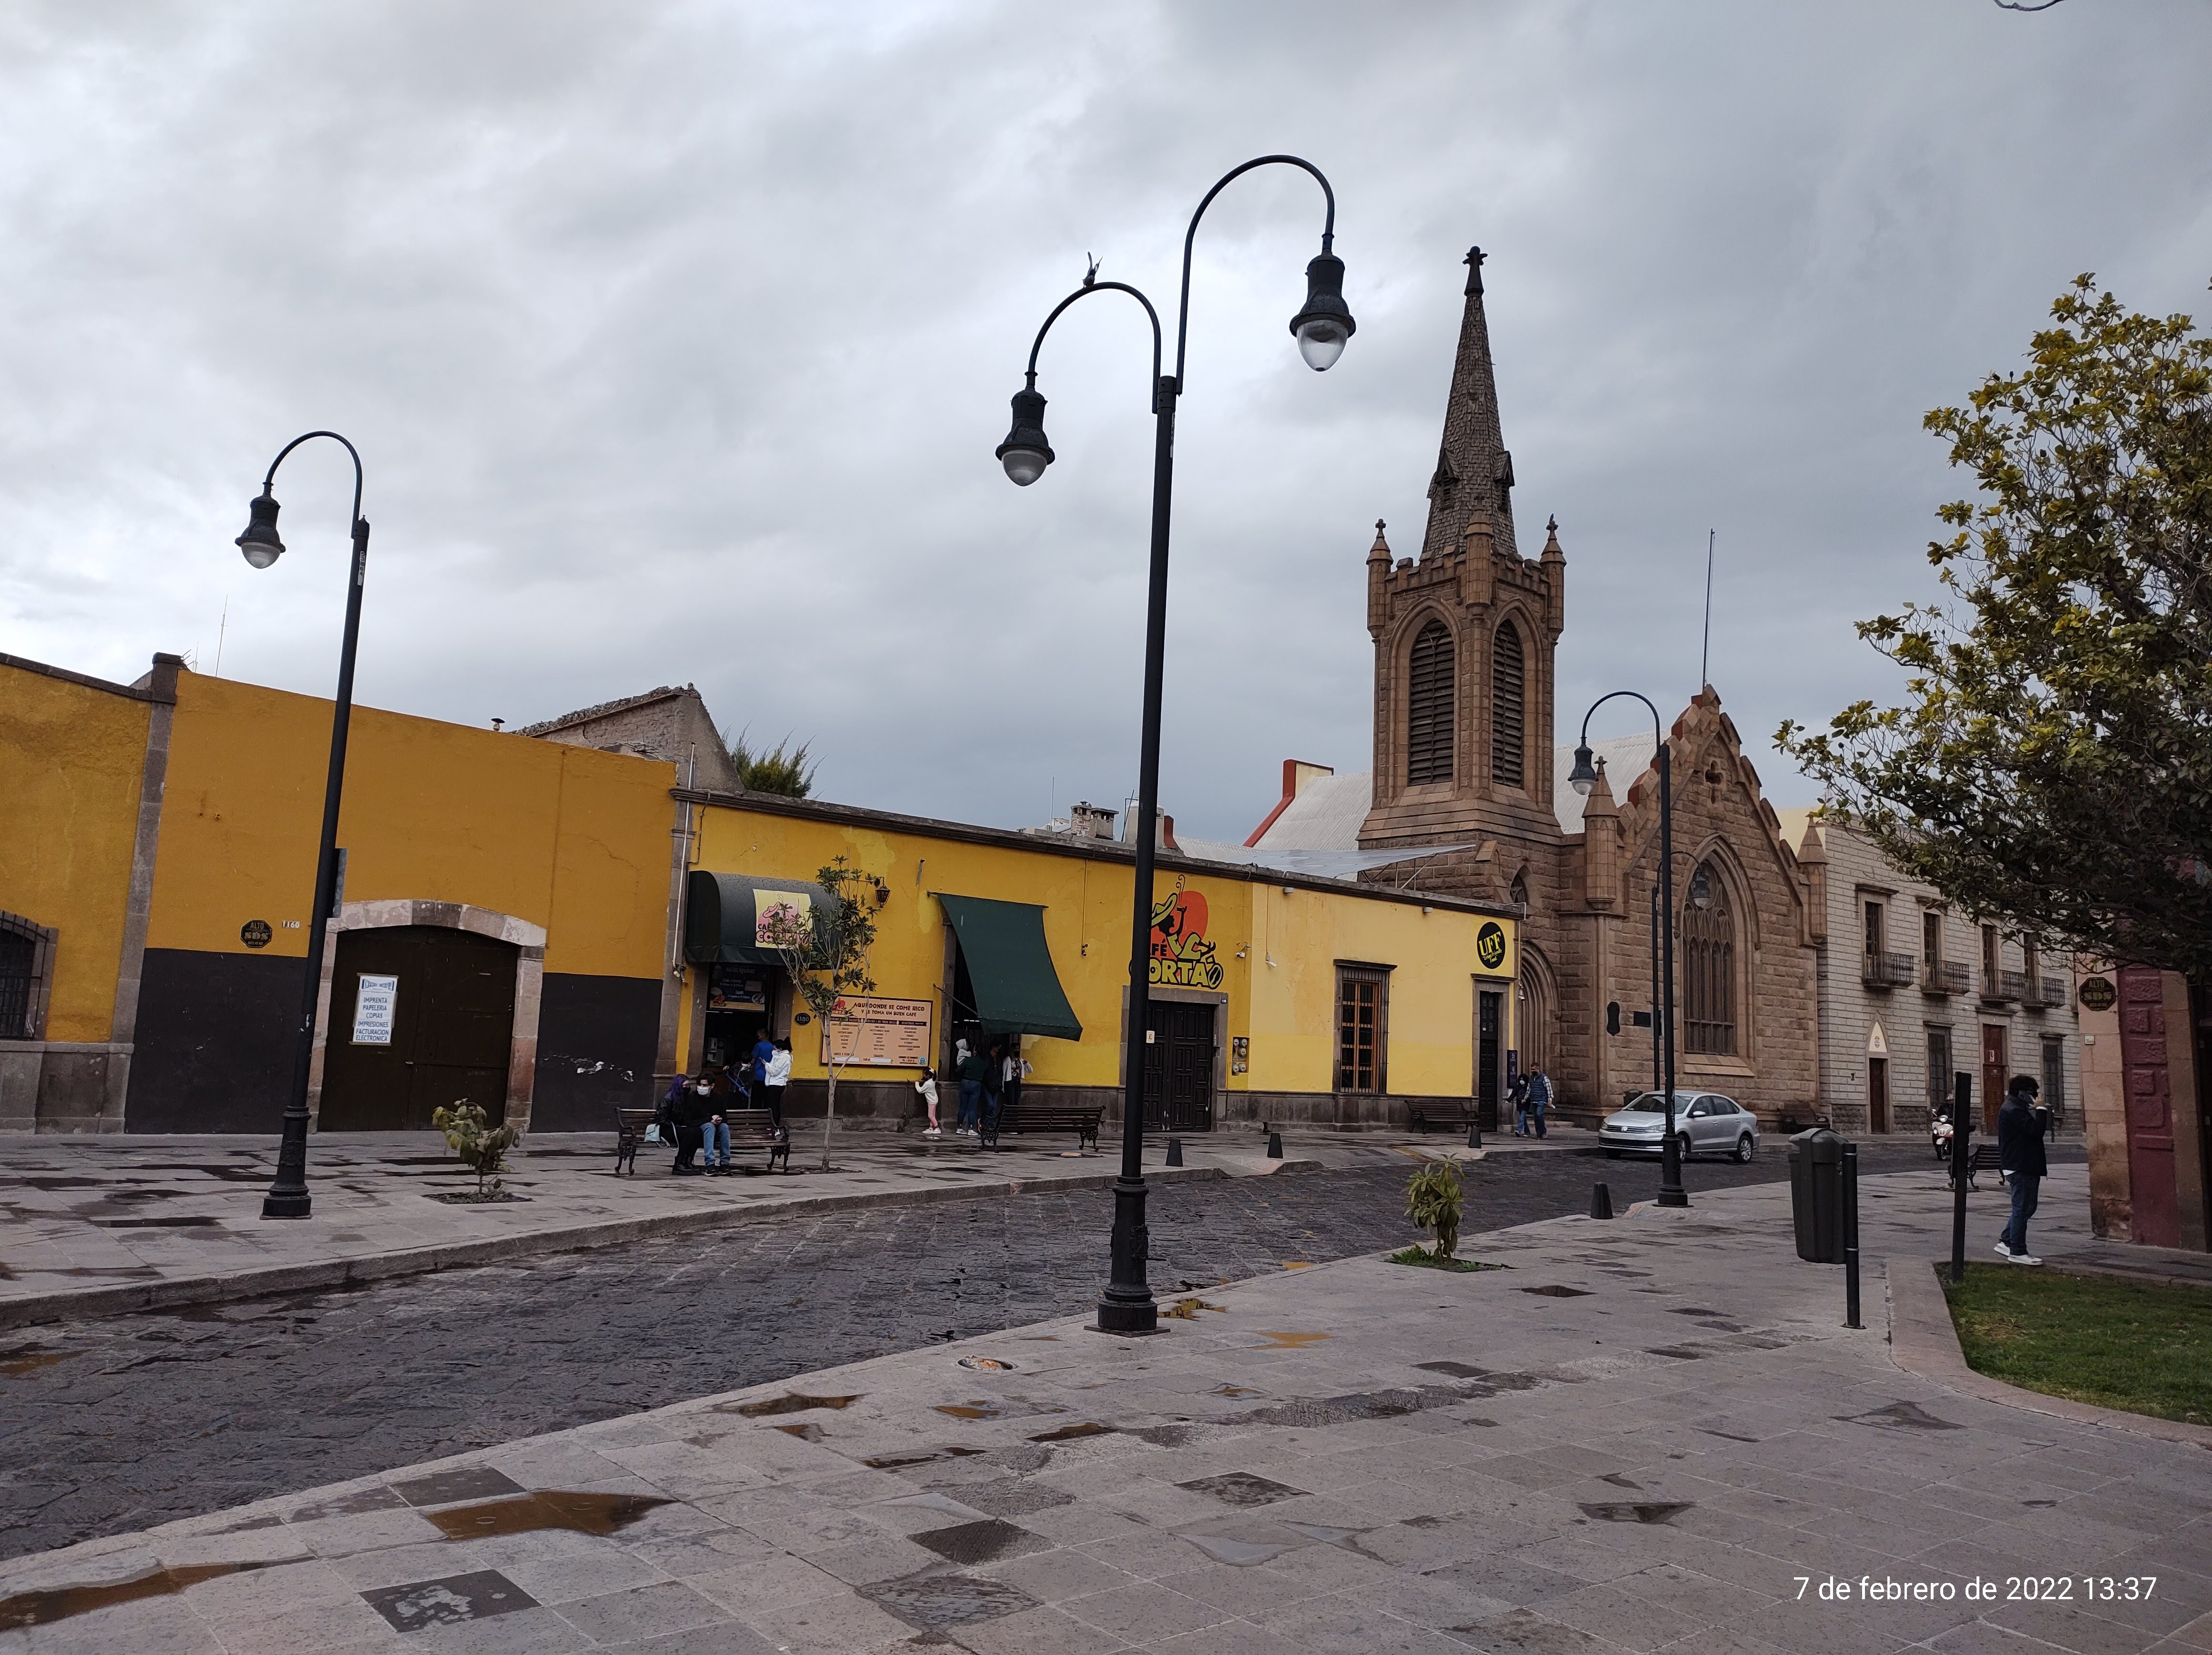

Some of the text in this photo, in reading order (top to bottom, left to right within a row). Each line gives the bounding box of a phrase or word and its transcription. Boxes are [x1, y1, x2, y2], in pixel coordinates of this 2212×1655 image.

[283, 920, 300, 929] 1160
[1151, 938, 1167, 956] FÉ
[1478, 931, 1501, 955] UFF
[2084, 992, 2111, 1000] SDS
